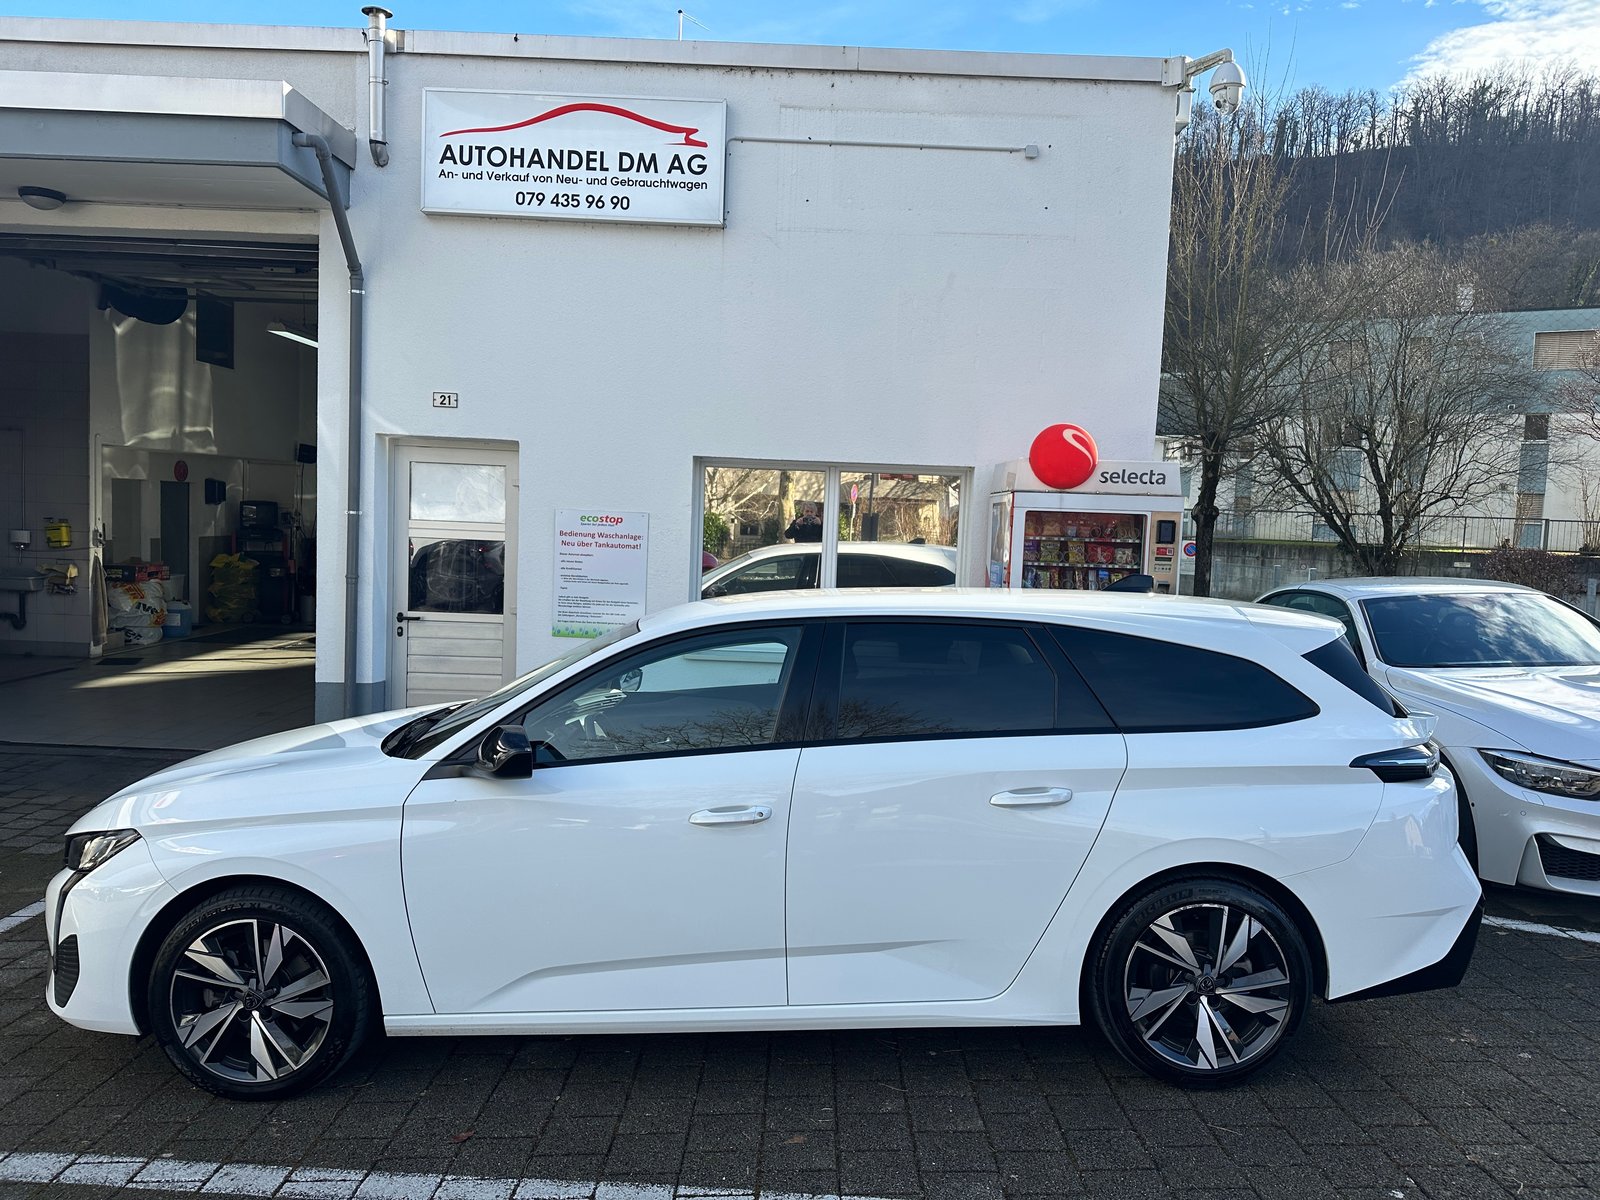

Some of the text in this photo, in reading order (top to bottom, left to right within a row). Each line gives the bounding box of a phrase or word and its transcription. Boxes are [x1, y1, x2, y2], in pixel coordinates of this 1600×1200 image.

[439, 144, 708, 176] AUTOHANDEL DM AG
[438, 169, 708, 191] An- und Verkauf von Neu- und Gebrauchtwagen
[515, 191, 631, 210] 079 435 96 90
[439, 394, 451, 406] 21
[1099, 469, 1166, 485] selecta
[580, 515, 623, 525] ecostop
[559, 530, 644, 541] Bedienung Waschanlage:
[577, 540, 592, 548] über
[594, 541, 642, 550] Tankautomat!
